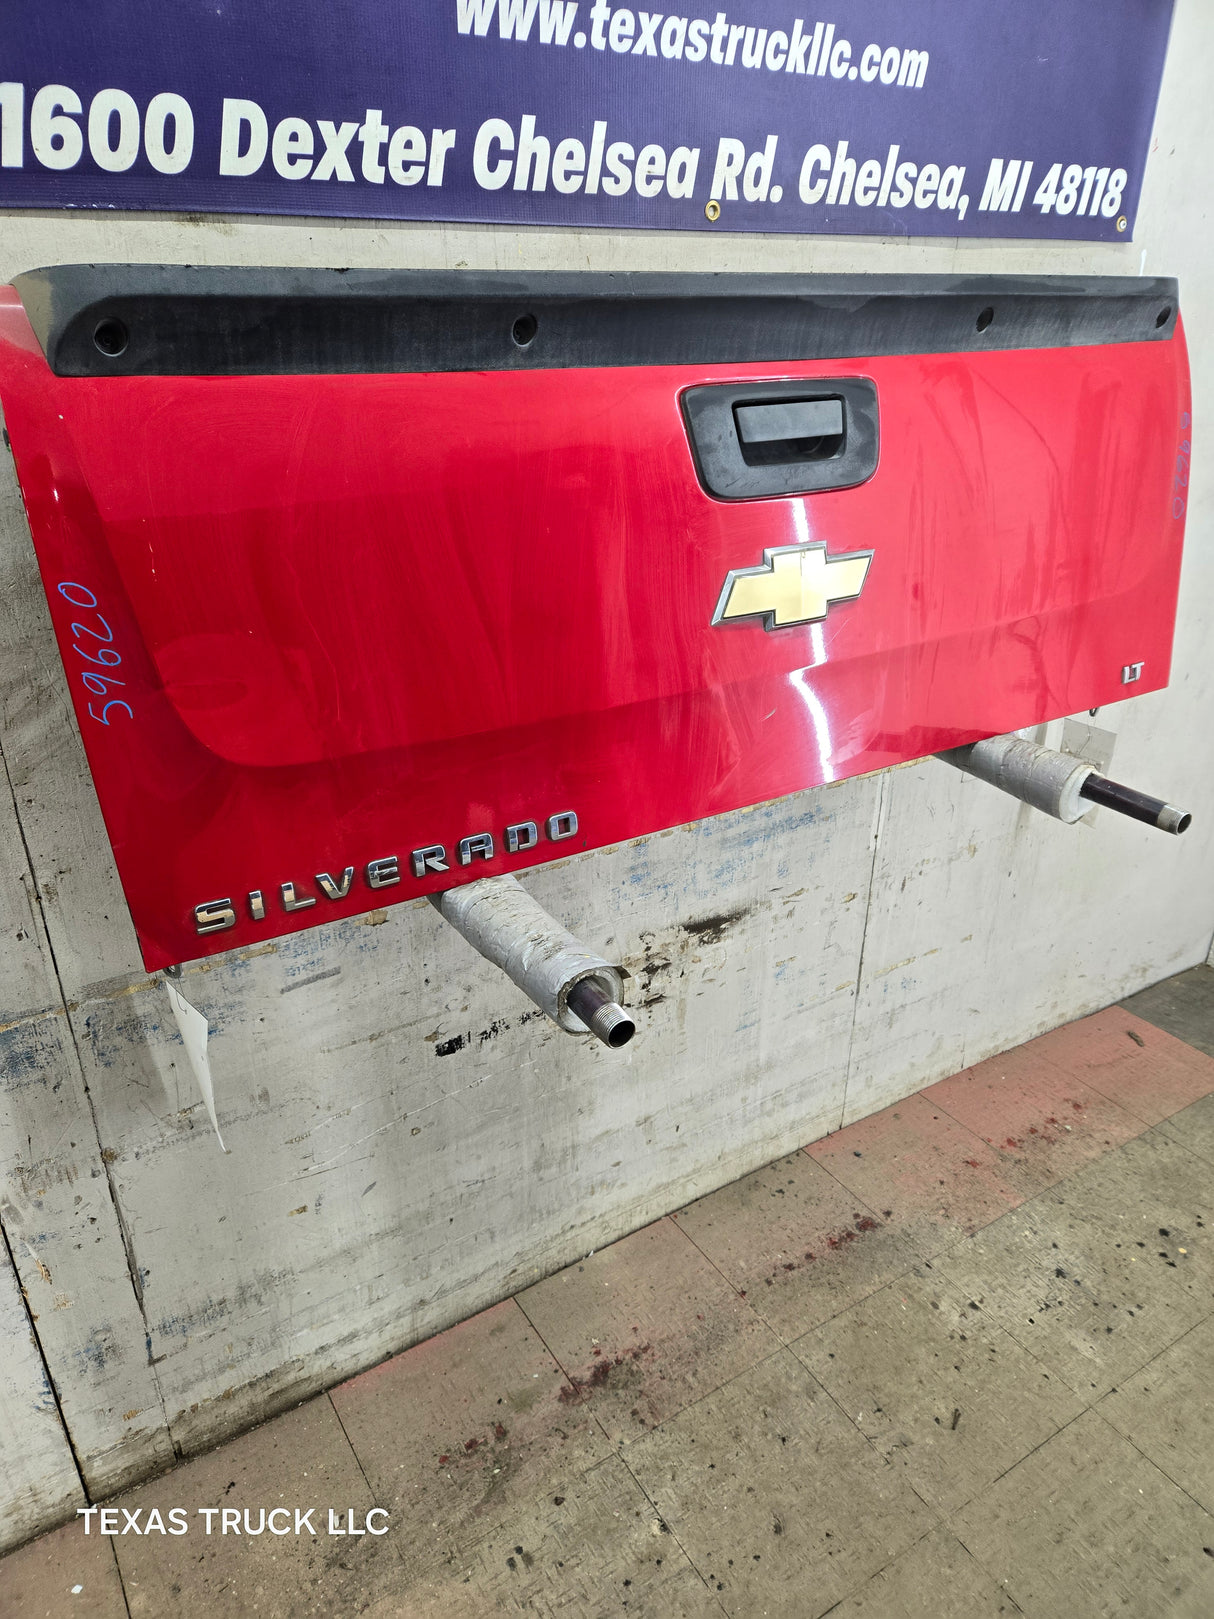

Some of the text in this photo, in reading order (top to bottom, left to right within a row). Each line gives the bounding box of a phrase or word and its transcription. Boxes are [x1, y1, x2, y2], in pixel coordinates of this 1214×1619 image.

[456, 0, 930, 89] www.texastruckllc.com
[0, 82, 1128, 221] 1600 Dexter Chelsea Rd. Chelsea, MI 48118
[1172, 411, 1190, 520] 59620
[57, 581, 134, 726] 59620
[1122, 661, 1145, 685] LT
[194, 809, 580, 936] SILVERADO
